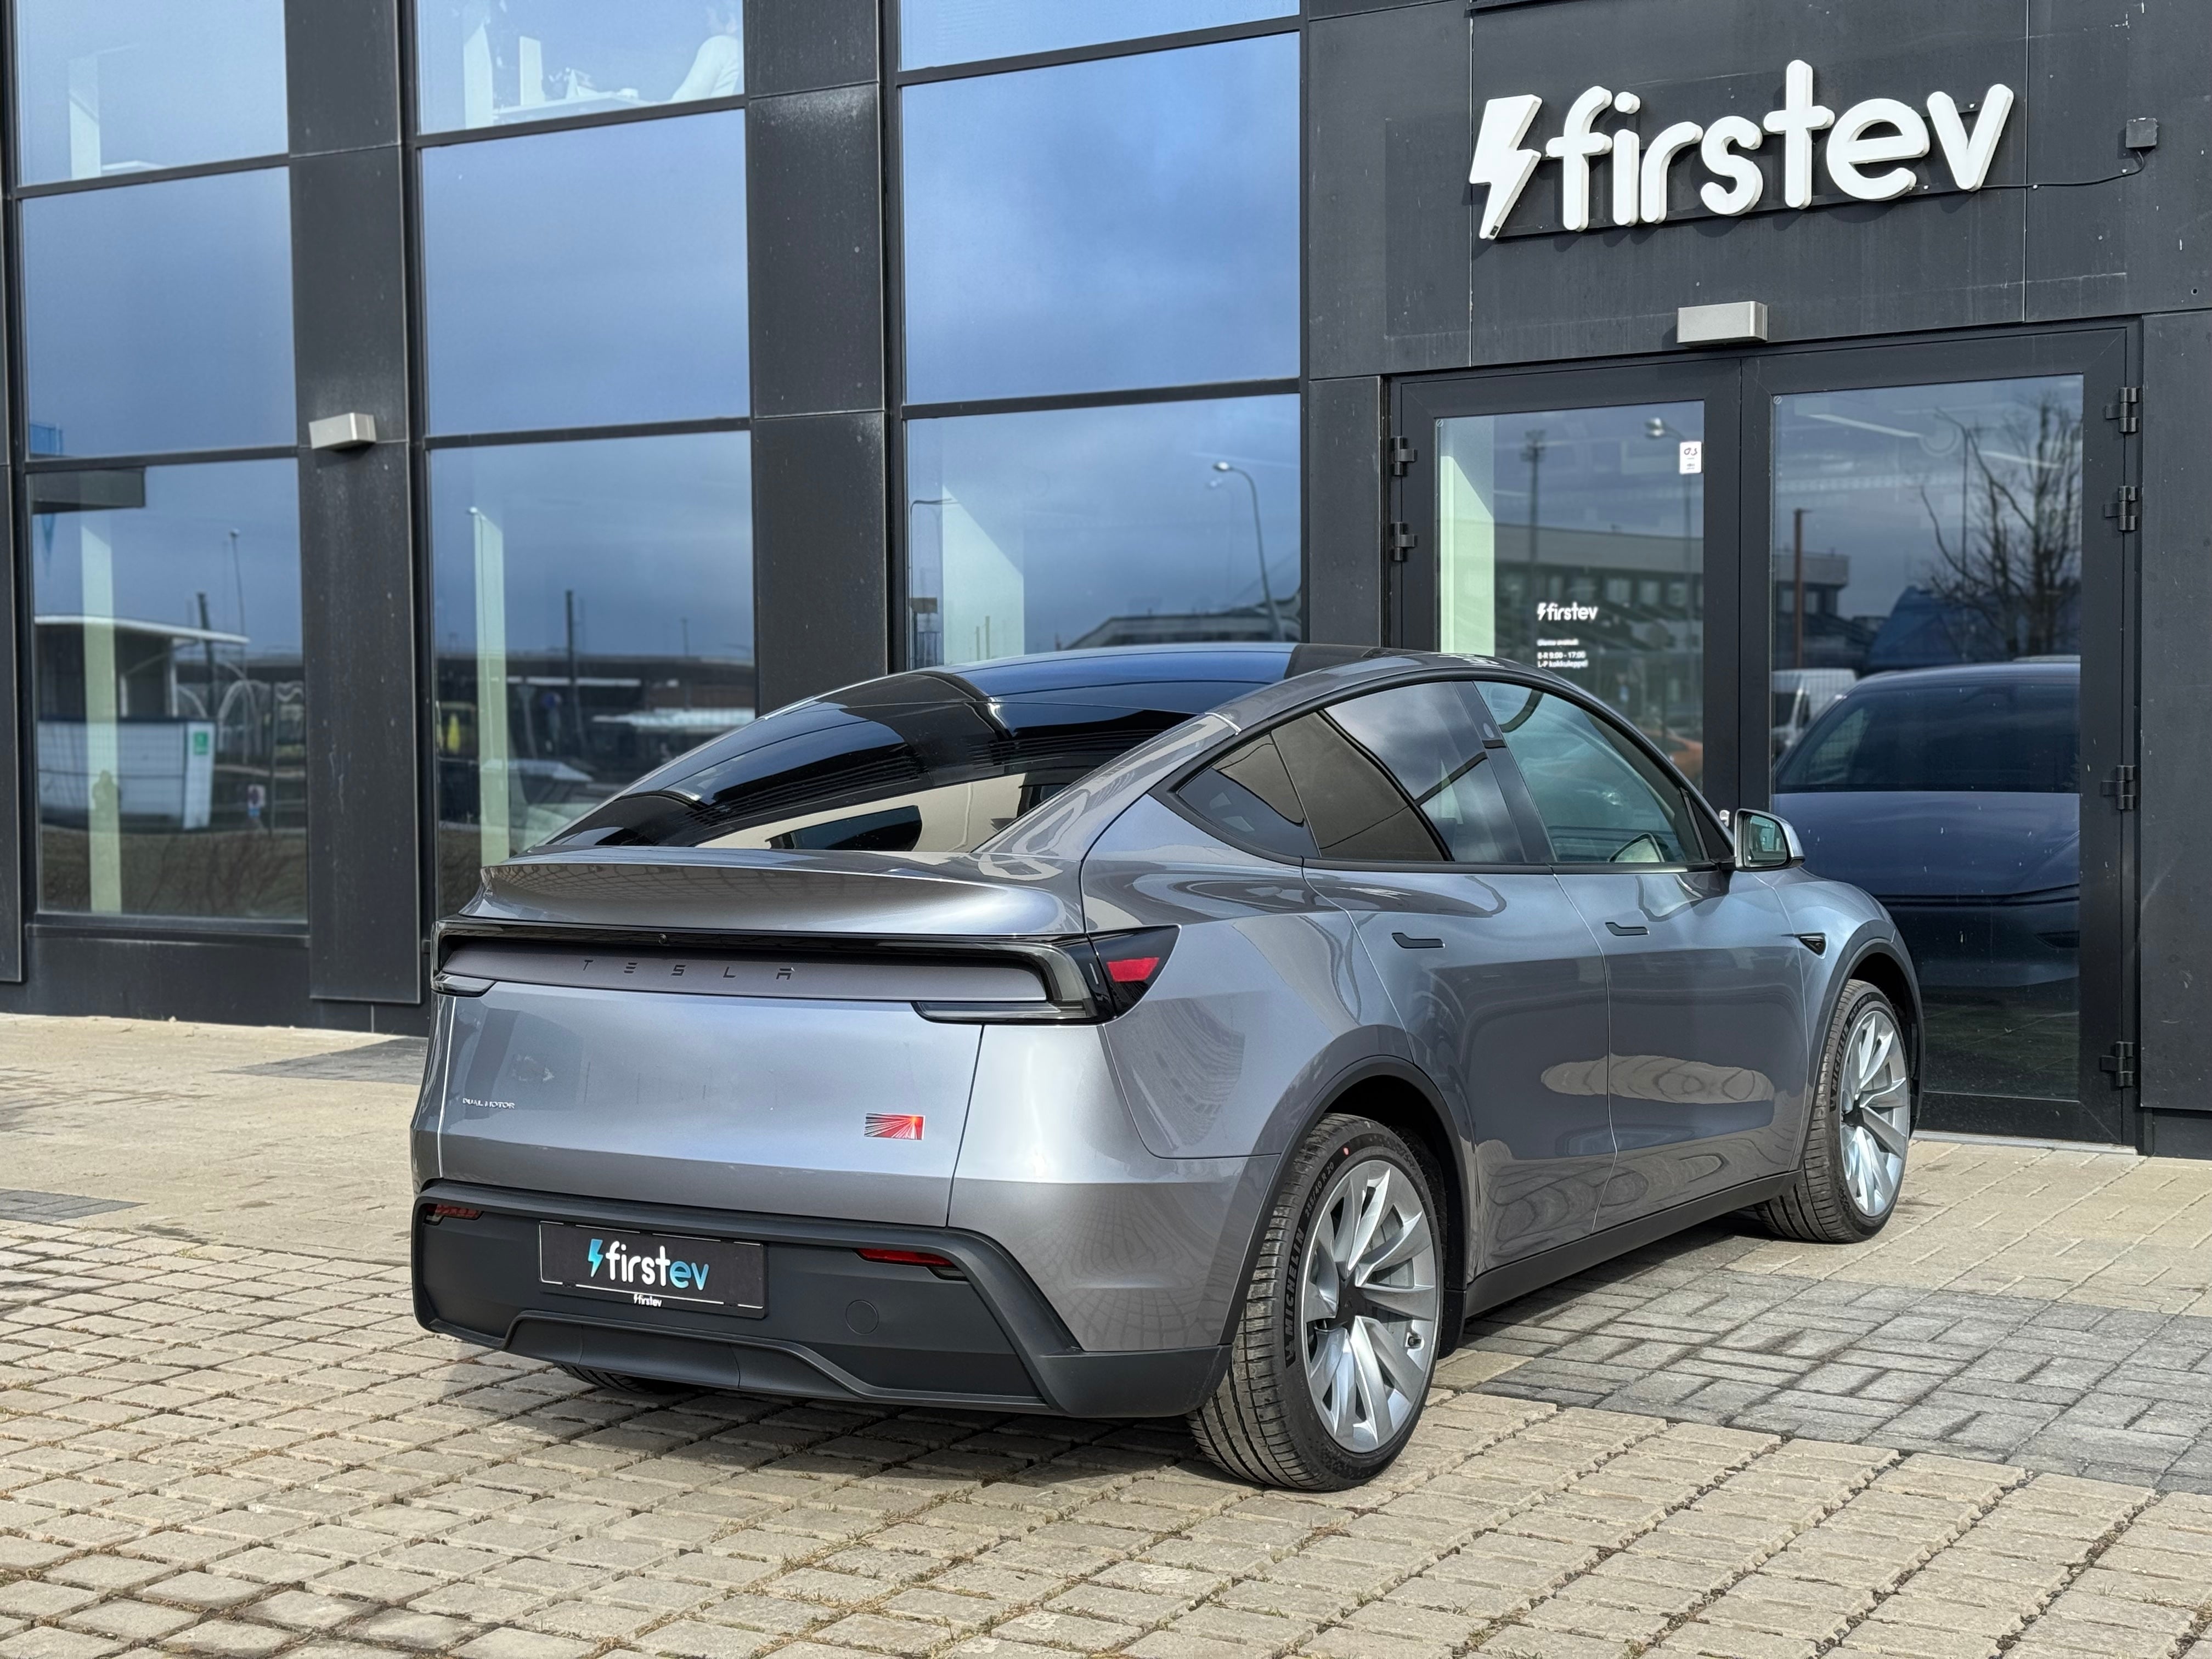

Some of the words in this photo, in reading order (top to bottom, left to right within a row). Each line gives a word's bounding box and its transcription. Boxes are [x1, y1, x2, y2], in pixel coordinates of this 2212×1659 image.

[1545, 59, 2015, 232] firstev
[1547, 601, 1598, 620] firstev
[583, 960, 792, 980] TESLA
[462, 1098, 483, 1107] DUAL
[1305, 1180, 1322, 1218] 255/40
[1327, 1162, 1334, 1175] 20
[606, 1240, 709, 1291] firstev
[1285, 1227, 1305, 1336] MICHELIN
